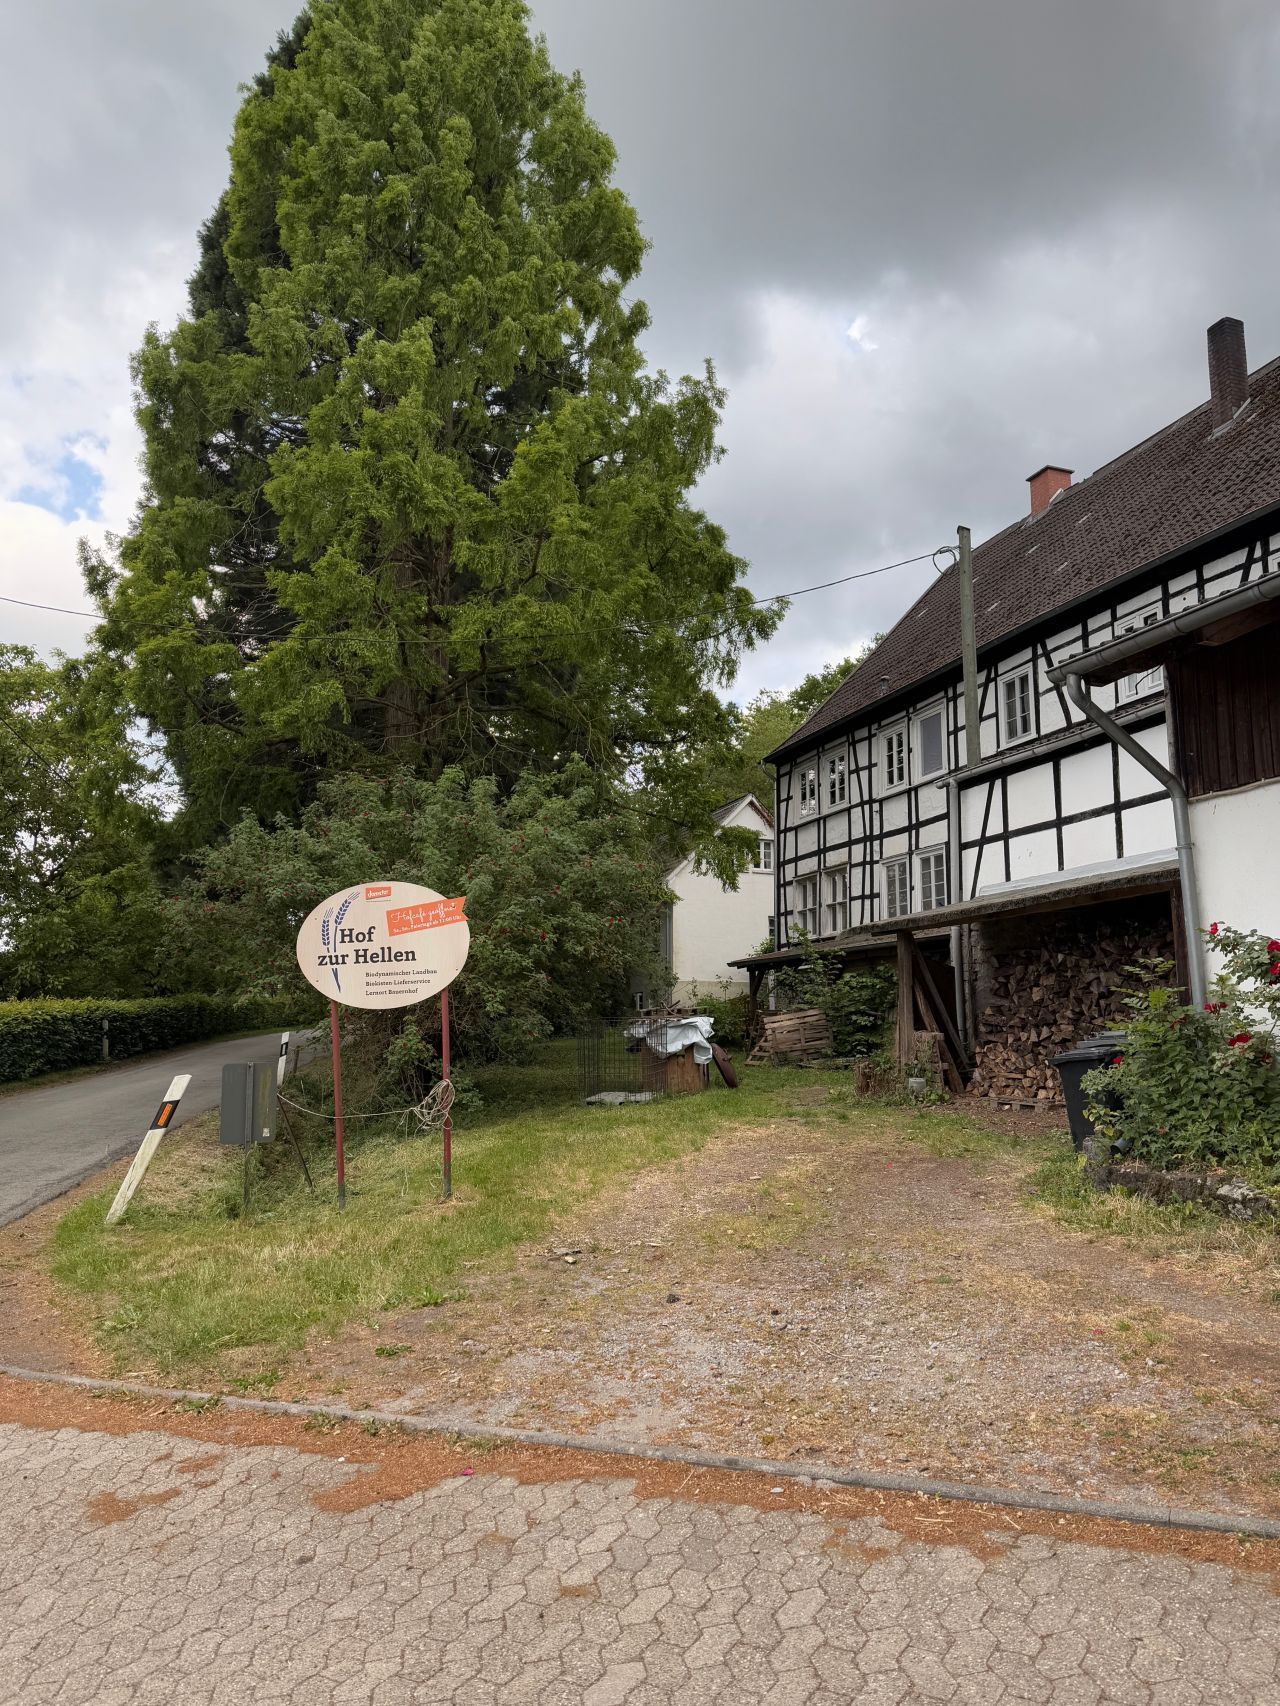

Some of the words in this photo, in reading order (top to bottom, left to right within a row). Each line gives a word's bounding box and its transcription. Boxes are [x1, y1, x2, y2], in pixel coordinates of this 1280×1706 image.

[339, 926, 376, 943] Hof
[317, 953, 349, 966] zur
[353, 946, 417, 964] Hellen
[365, 970, 411, 978] Biodynamischer
